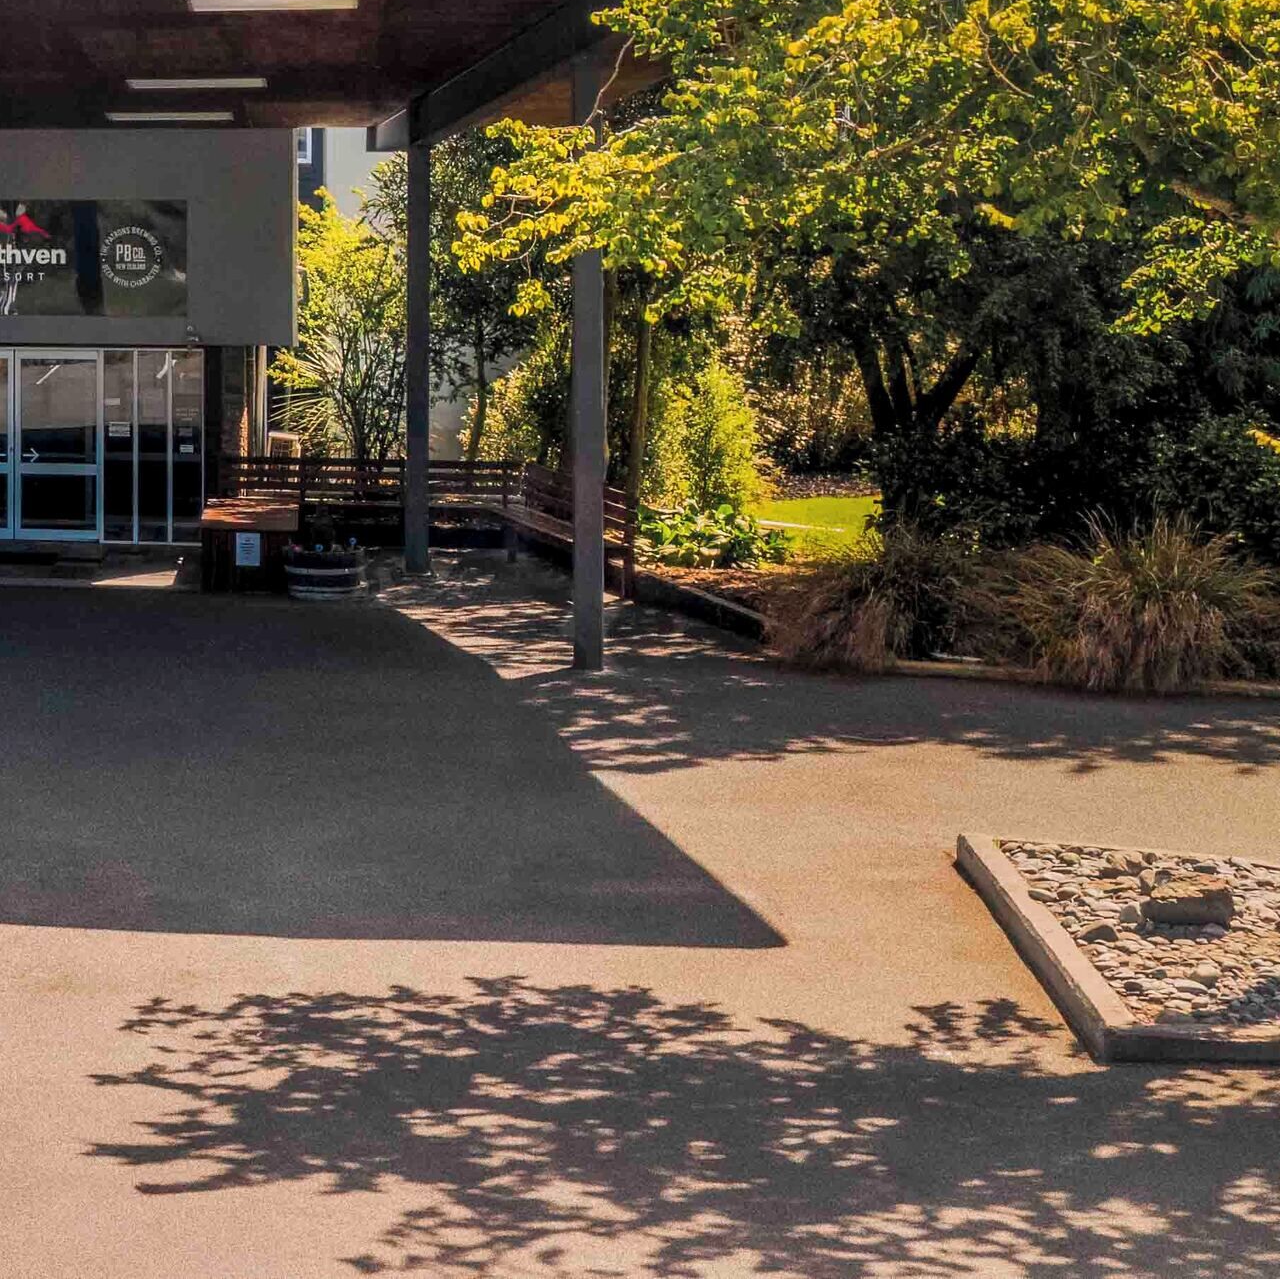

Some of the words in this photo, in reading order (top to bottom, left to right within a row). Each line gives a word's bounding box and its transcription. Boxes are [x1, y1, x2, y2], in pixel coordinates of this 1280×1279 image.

[104, 226, 131, 245] PATRONS
[113, 276, 129, 288] WITH
[130, 264, 160, 288] CHARACTER
